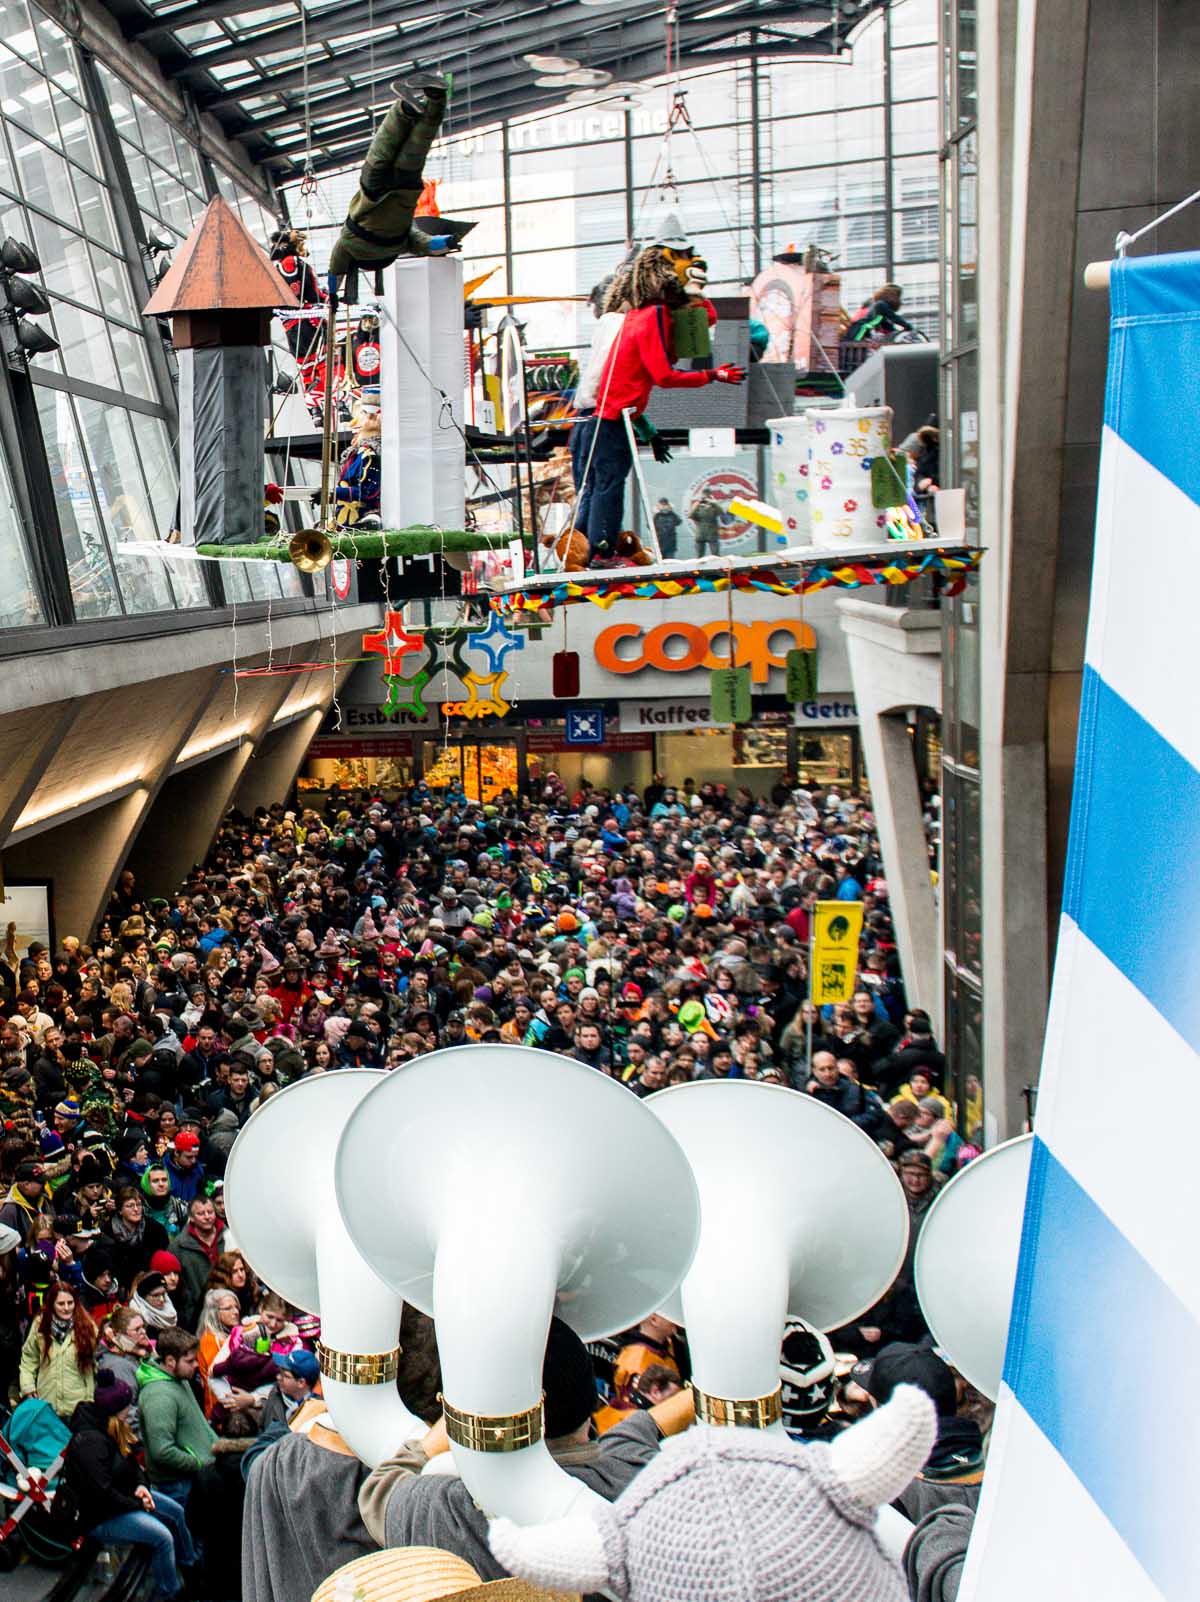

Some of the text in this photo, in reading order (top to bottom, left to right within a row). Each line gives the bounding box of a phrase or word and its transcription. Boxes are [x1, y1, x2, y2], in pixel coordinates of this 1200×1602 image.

[846, 438, 868, 457] 35
[594, 620, 818, 684] coop
[639, 705, 711, 725] Kaffee
